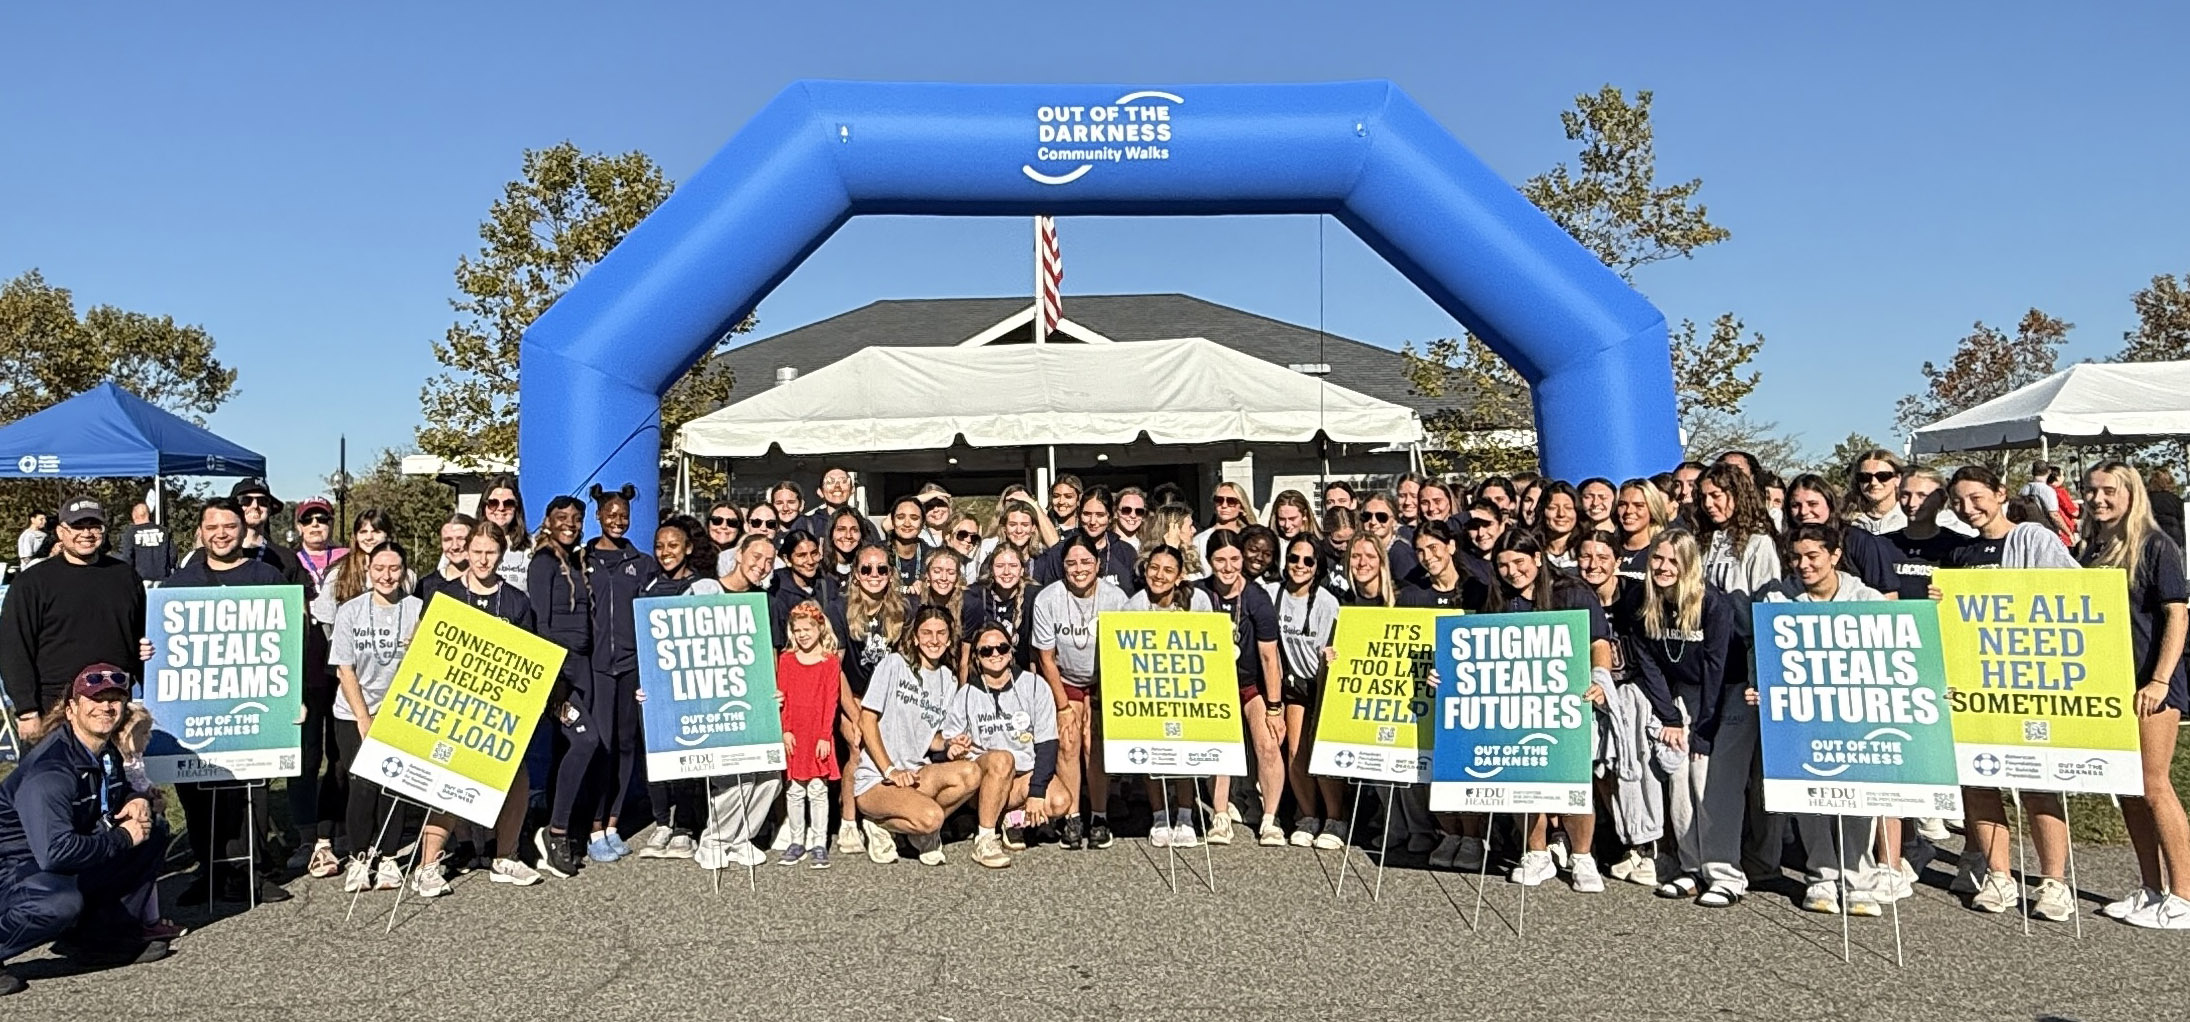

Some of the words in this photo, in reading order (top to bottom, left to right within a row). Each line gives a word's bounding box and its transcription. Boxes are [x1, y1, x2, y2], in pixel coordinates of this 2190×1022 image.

[1038, 106, 1084, 122] OUT
[1090, 106, 1119, 122] OF
[1124, 106, 1170, 122] THE
[1038, 124, 1172, 142] DARKNESS
[1038, 146, 1122, 163] Community
[1124, 146, 1170, 160] Walks
[1896, 564, 1940, 576] LACROS
[164, 598, 286, 634] STIGMA
[1955, 594, 2015, 622] WE
[2028, 595, 2105, 624] ALL
[378, 628, 390, 636] to
[649, 604, 757, 640] STIGMA
[1054, 622, 1089, 636] Volun
[1384, 624, 1422, 641] IT'S
[1773, 614, 1922, 650] STIGMA
[167, 632, 281, 668] STEALS
[434, 620, 545, 681] CONNECTING
[1115, 630, 1158, 650] WE
[1166, 630, 1218, 652] ALL
[1366, 642, 1433, 660] NEVER
[1452, 624, 1574, 660] STIGMA
[1978, 627, 2085, 658] NEED
[656, 635, 756, 671] STEALS
[434, 640, 458, 662] TO
[461, 652, 531, 694] OTHERS
[1132, 653, 1206, 675] NEED
[1350, 658, 1388, 677] TOO
[1394, 660, 1432, 678] LAT
[1782, 650, 1919, 686] STEALS
[157, 664, 289, 702] DREAMS
[444, 665, 504, 702] HELPS
[671, 666, 748, 702] LIVES
[1456, 659, 1568, 696] STEALS
[1980, 660, 2086, 690] HELP
[1134, 677, 1206, 699] HELP
[1337, 676, 1362, 694] TO
[1368, 678, 1408, 697] ASK
[1414, 681, 1436, 698] FO
[408, 672, 521, 737] LIGHTEN
[896, 690, 918, 706] Fight
[1770, 686, 1940, 725] FUTURES
[1952, 691, 2122, 719] SOMETIMES
[184, 715, 212, 727] OUT
[214, 714, 232, 725] OF
[234, 714, 260, 724] THE
[681, 714, 704, 724] OUT
[706, 714, 720, 723] OF
[724, 712, 745, 722] THE
[1112, 700, 1232, 720] SOMETIMES
[1352, 697, 1429, 724] HELP
[1444, 694, 1582, 730] FUTURES
[184, 724, 260, 738] DARKNESS
[393, 692, 448, 735] THE
[448, 719, 515, 763] LOAD
[682, 721, 746, 735] DARKNESS
[978, 724, 1004, 735] Fight
[1474, 745, 1499, 756] OUT
[1504, 745, 1520, 756] OF
[1522, 745, 1548, 756] THE
[1811, 740, 1844, 752] OUT
[1846, 740, 1867, 752] OF
[1870, 741, 1902, 753] THE
[680, 763, 715, 772] HEALTH
[689, 753, 714, 764] FDU
[1474, 756, 1548, 766] DARKNESS
[1812, 752, 1904, 766] DARKNESS
[1465, 798, 1504, 806] HEALTH
[1476, 788, 1506, 798] FDU
[1808, 798, 1856, 808] HEALTH
[1820, 787, 1856, 800] FDU
